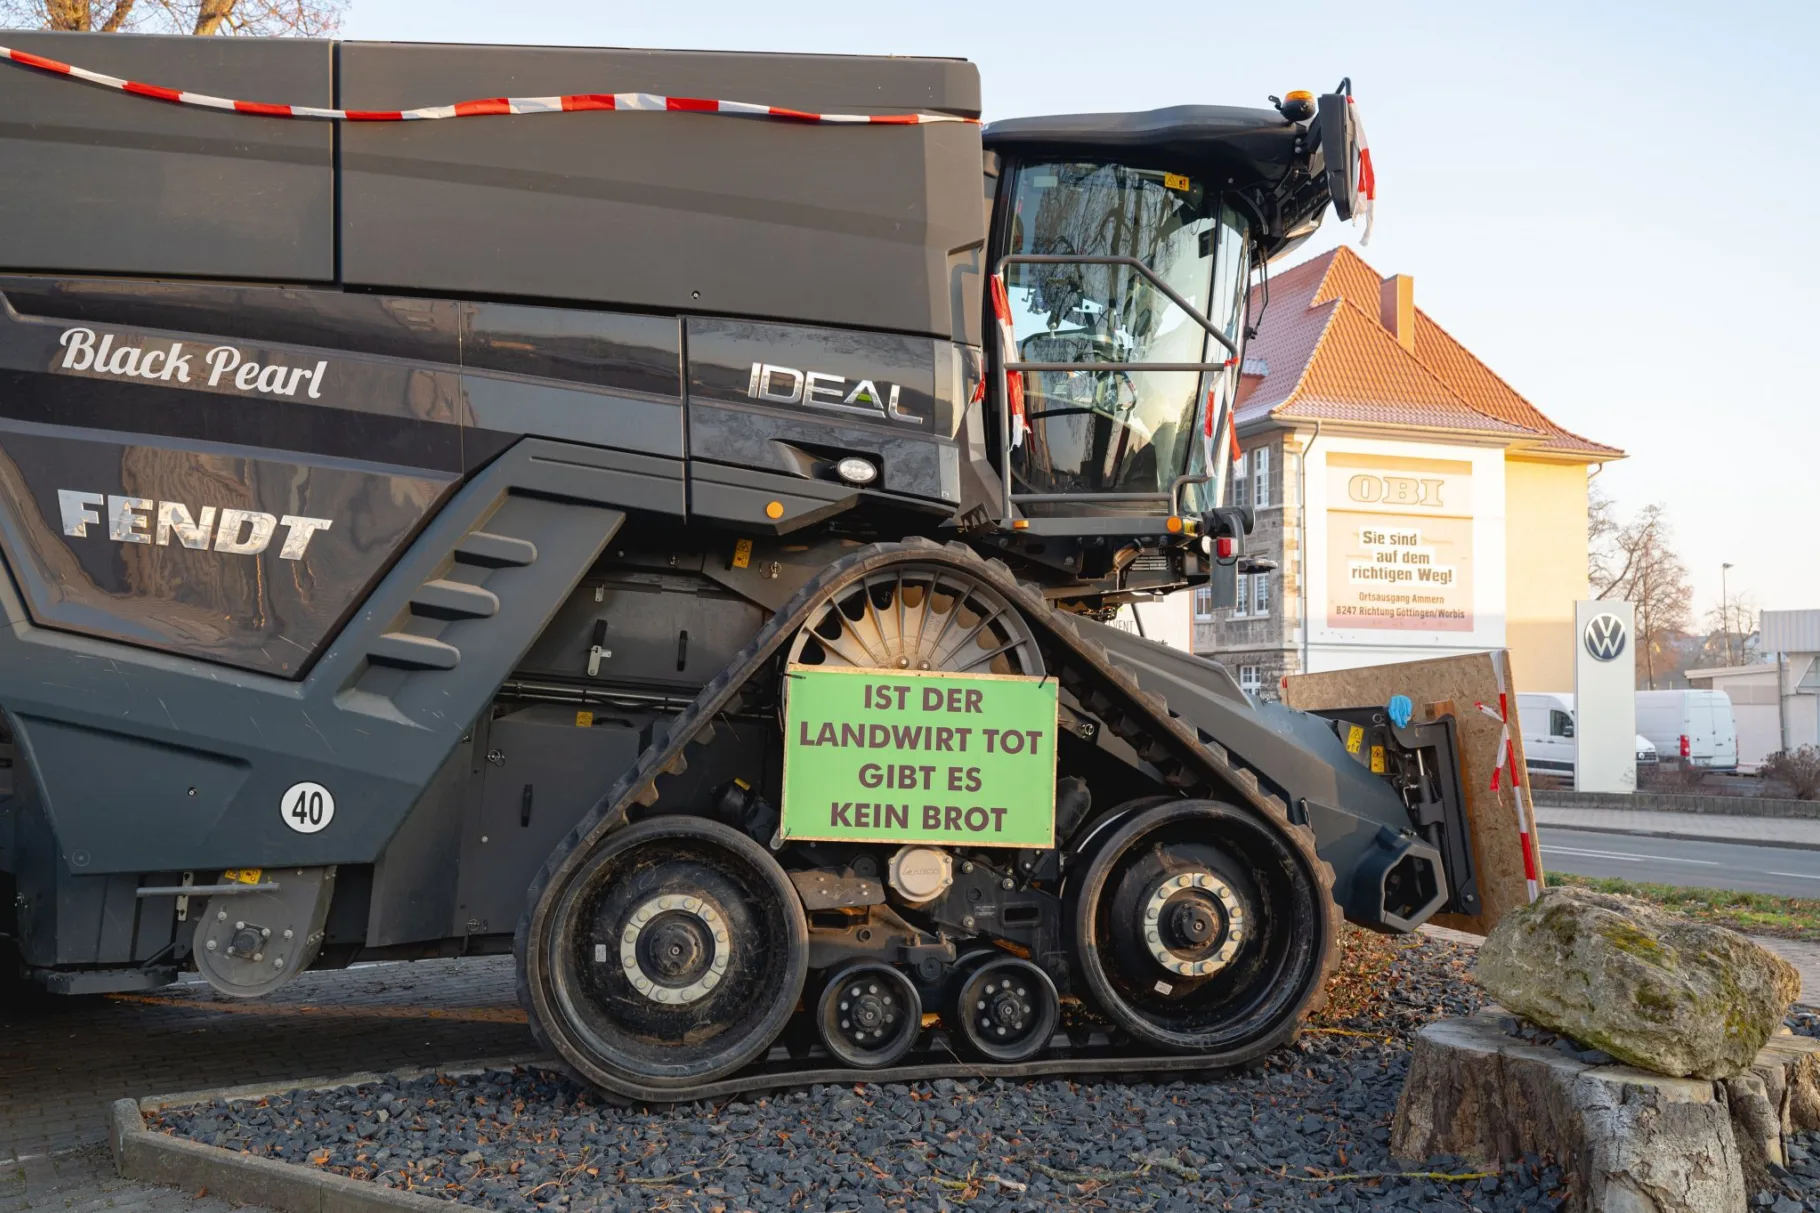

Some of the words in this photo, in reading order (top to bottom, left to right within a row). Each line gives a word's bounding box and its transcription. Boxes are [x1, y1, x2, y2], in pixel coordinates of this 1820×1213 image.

[60, 327, 193, 383] Black
[206, 346, 328, 399] Pearl
[748, 362, 923, 424] IDEAL
[1348, 474, 1445, 507] OBI
[57, 489, 333, 560] FENDT
[1362, 530, 1385, 545] Sie
[1389, 532, 1417, 546] sind
[1376, 550, 1398, 564] auf
[1402, 551, 1430, 564] dem
[1352, 565, 1412, 583] richtigen
[1418, 567, 1452, 585] Weg!
[1336, 605, 1357, 615] B247
[1359, 606, 1395, 618] Richtung
[1359, 592, 1410, 605] Ortsausgang
[1412, 594, 1445, 605] Ammern
[864, 684, 911, 710] IST
[922, 687, 983, 713] DER
[800, 721, 972, 752] LANDWIRT
[982, 728, 1043, 755] TOT
[858, 763, 936, 790] GIBT
[947, 766, 982, 793] ES
[292, 790, 323, 825] 40
[830, 802, 909, 829] KEIN
[922, 804, 1008, 832] BROT
